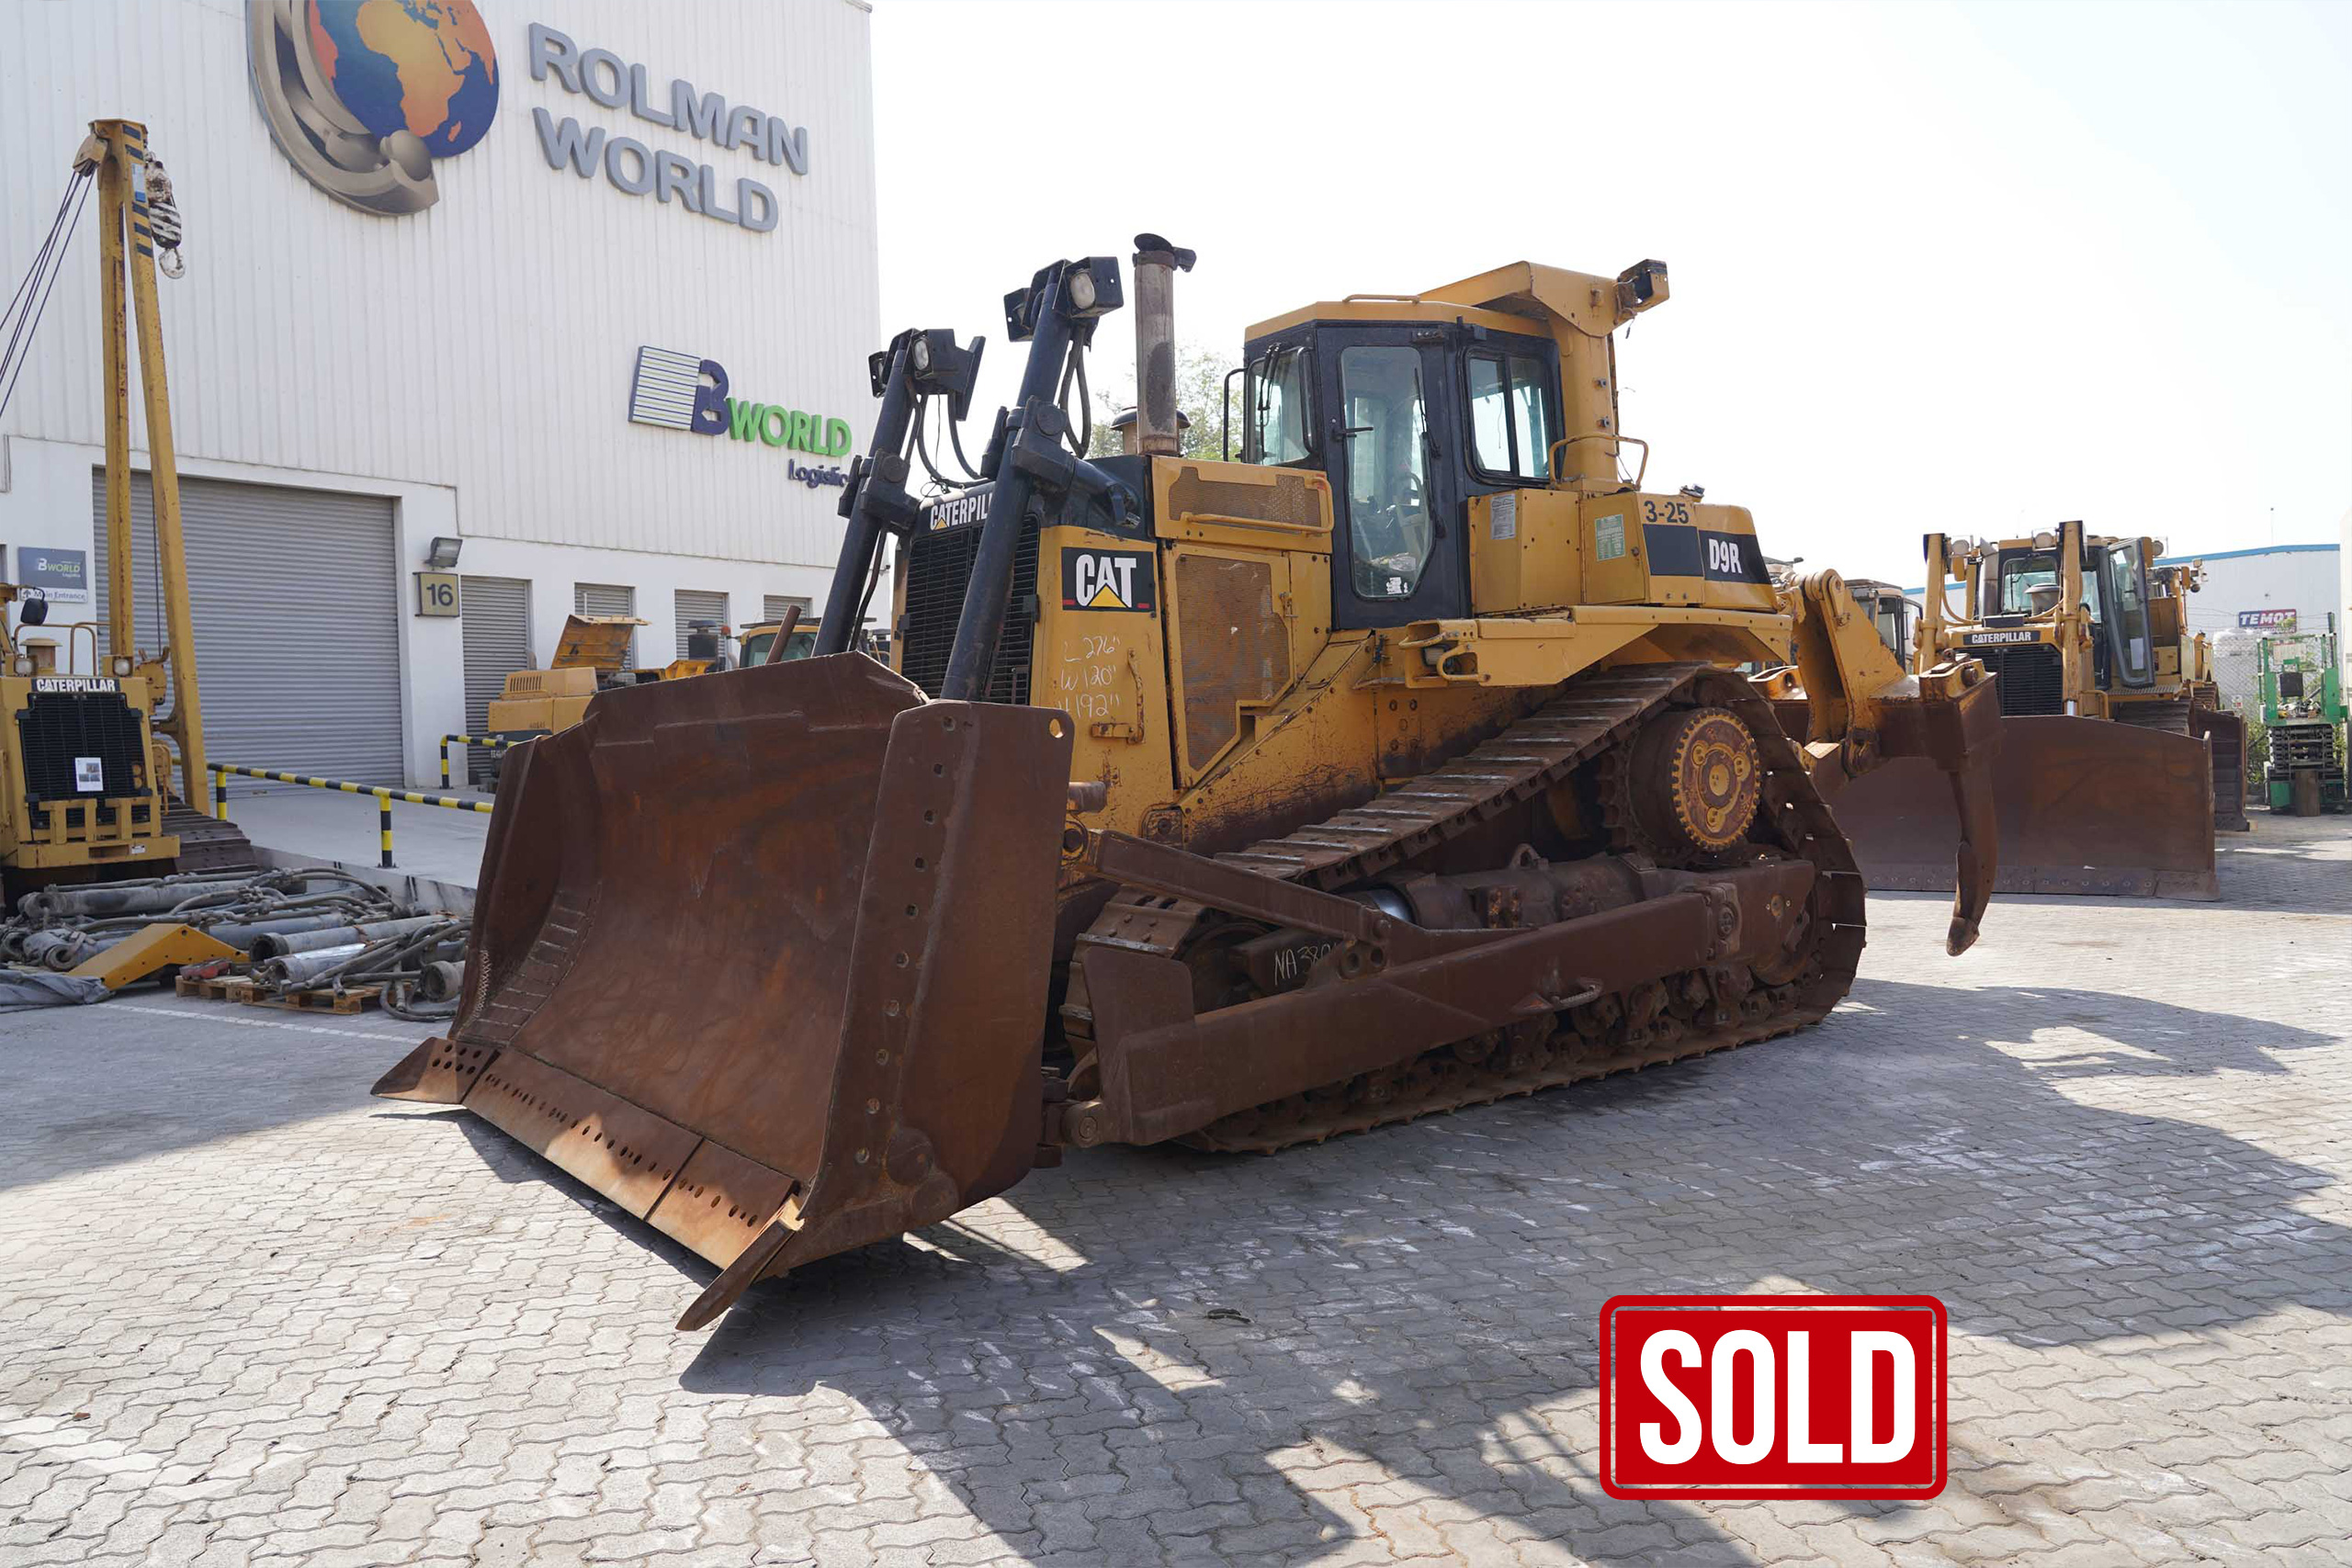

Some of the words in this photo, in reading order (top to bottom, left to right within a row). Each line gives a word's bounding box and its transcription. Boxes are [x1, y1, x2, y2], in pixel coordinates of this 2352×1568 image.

[528, 22, 808, 175] ROLMAN
[532, 107, 779, 232] WORLD
[788, 458, 851, 489] Logistic
[930, 492, 993, 530] CATERPIL
[1644, 501, 1689, 524] 3-25
[1709, 538, 1742, 574] D9R
[426, 583, 454, 606] 16
[1076, 554, 1136, 608] CAT
[1972, 631, 2031, 644] CATERPILLAR
[36, 678, 116, 693] CATERPILLAR
